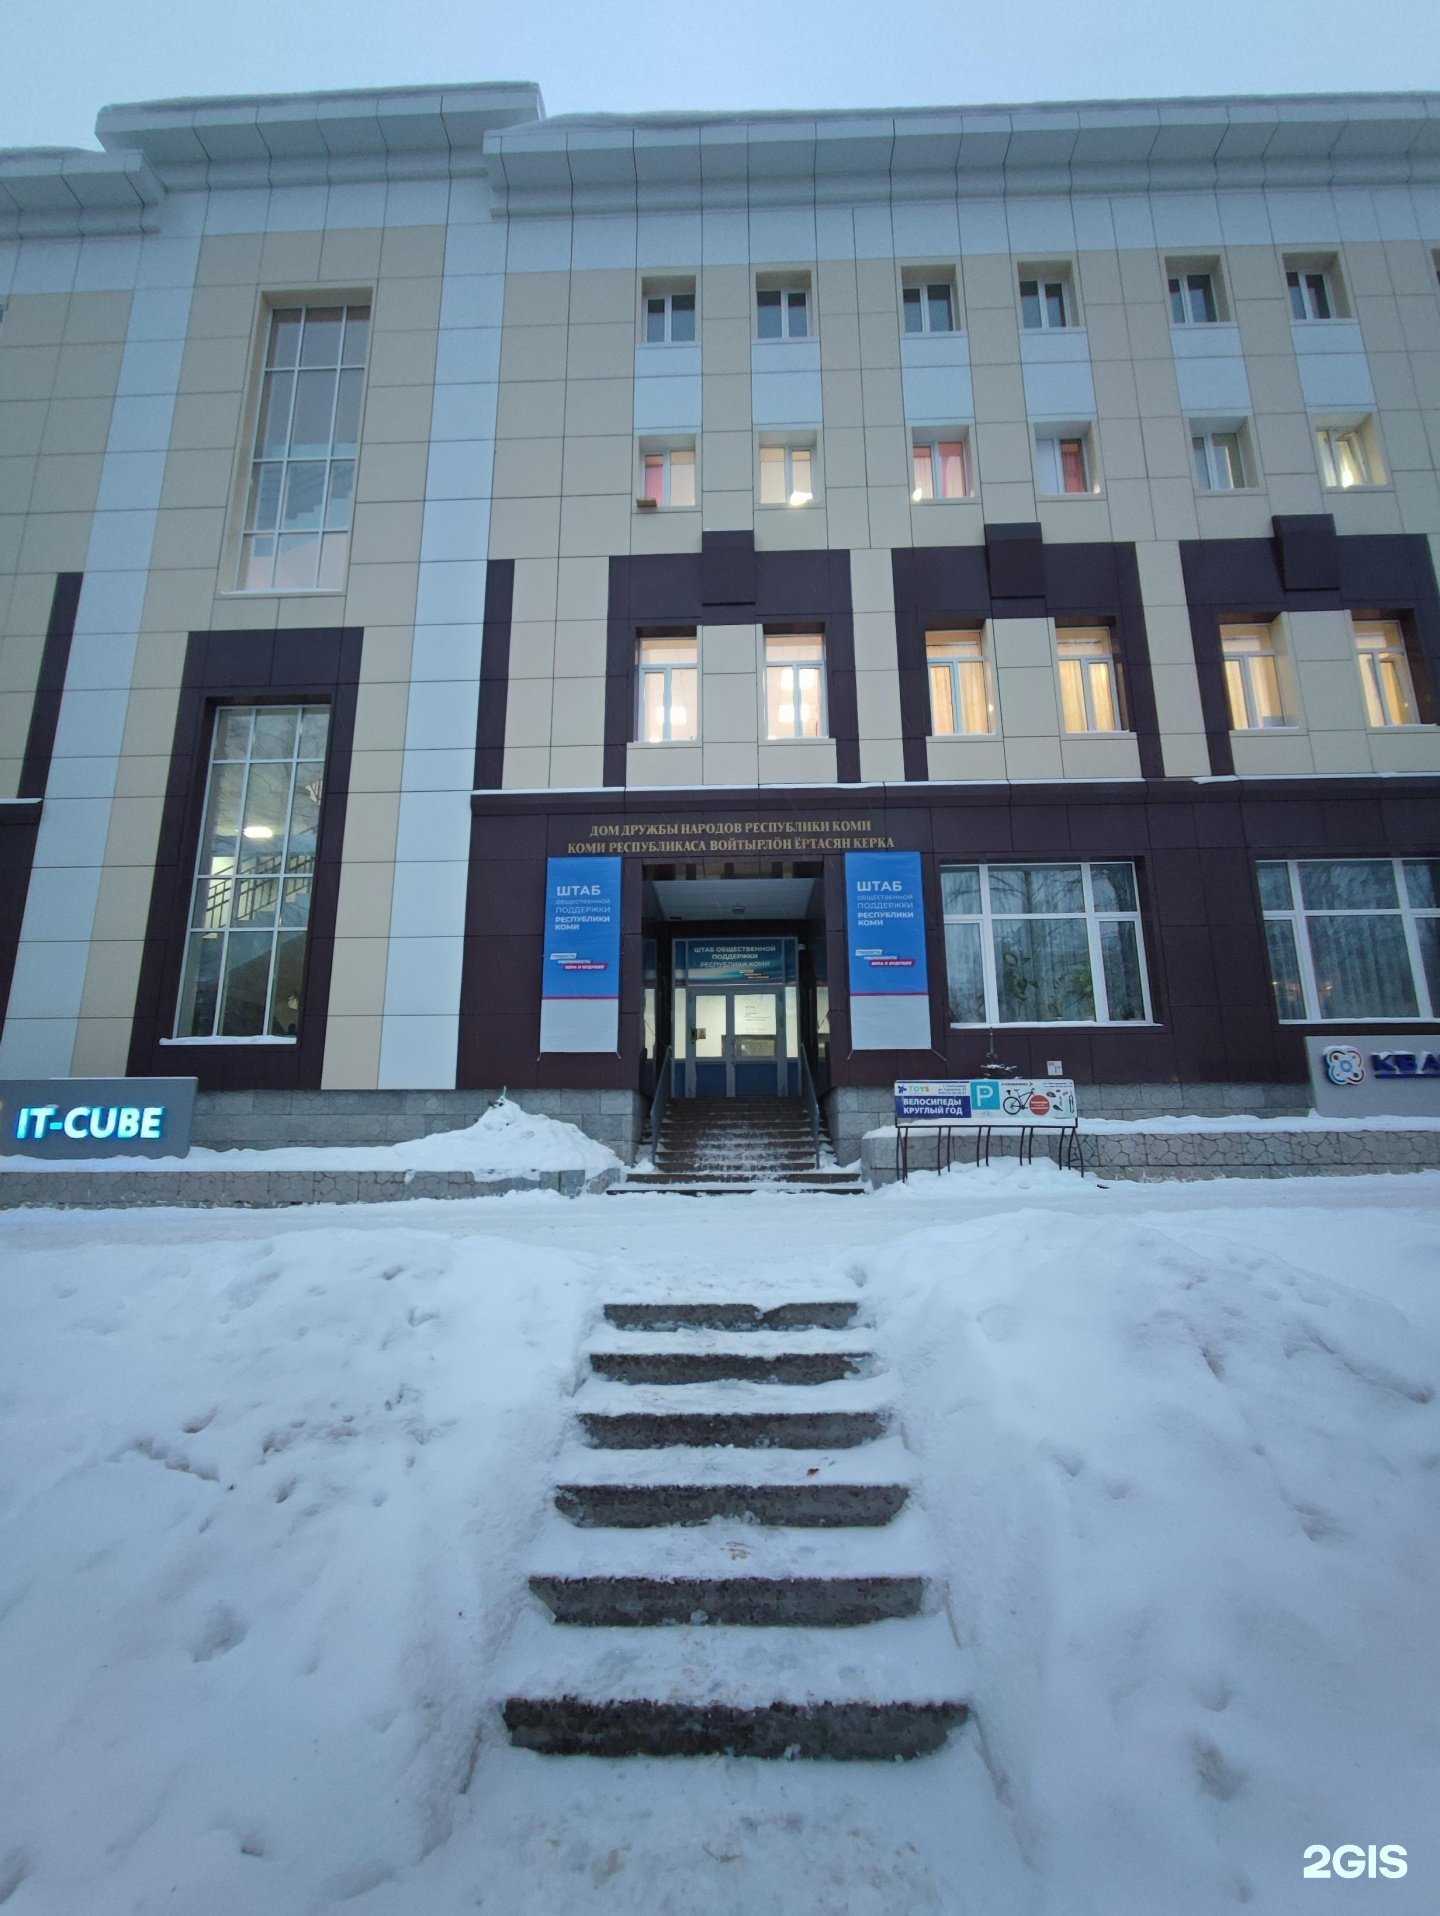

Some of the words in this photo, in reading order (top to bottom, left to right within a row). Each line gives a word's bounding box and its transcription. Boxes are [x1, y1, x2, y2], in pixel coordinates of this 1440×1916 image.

[590, 824, 619, 837] ДОМ
[621, 823, 678, 836] ДРУЖБЫ
[681, 822, 742, 835] НАРОДОВ
[745, 821, 830, 833] РЕСПУБЛИКИ
[832, 820, 871, 832] КОМИ
[568, 842, 606, 854] КОМИ
[609, 840, 706, 853] РЕСПУБЛИКАСА
[853, 836, 895, 849] КЕРКА
[556, 885, 601, 897] ШТАБ
[856, 881, 902, 892] ШТАБ
[555, 915, 610, 923] РЕСПУБЛИКИ
[857, 911, 914, 919] РЕСПУБЛИКИ
[903, 1098, 962, 1106] ВЕЛОСИПЕДЫ
[903, 1106, 944, 1114] КРУГЛЫЙ
[945, 1107, 963, 1116] ГОД
[16, 1105, 164, 1139] IT-CUBE
